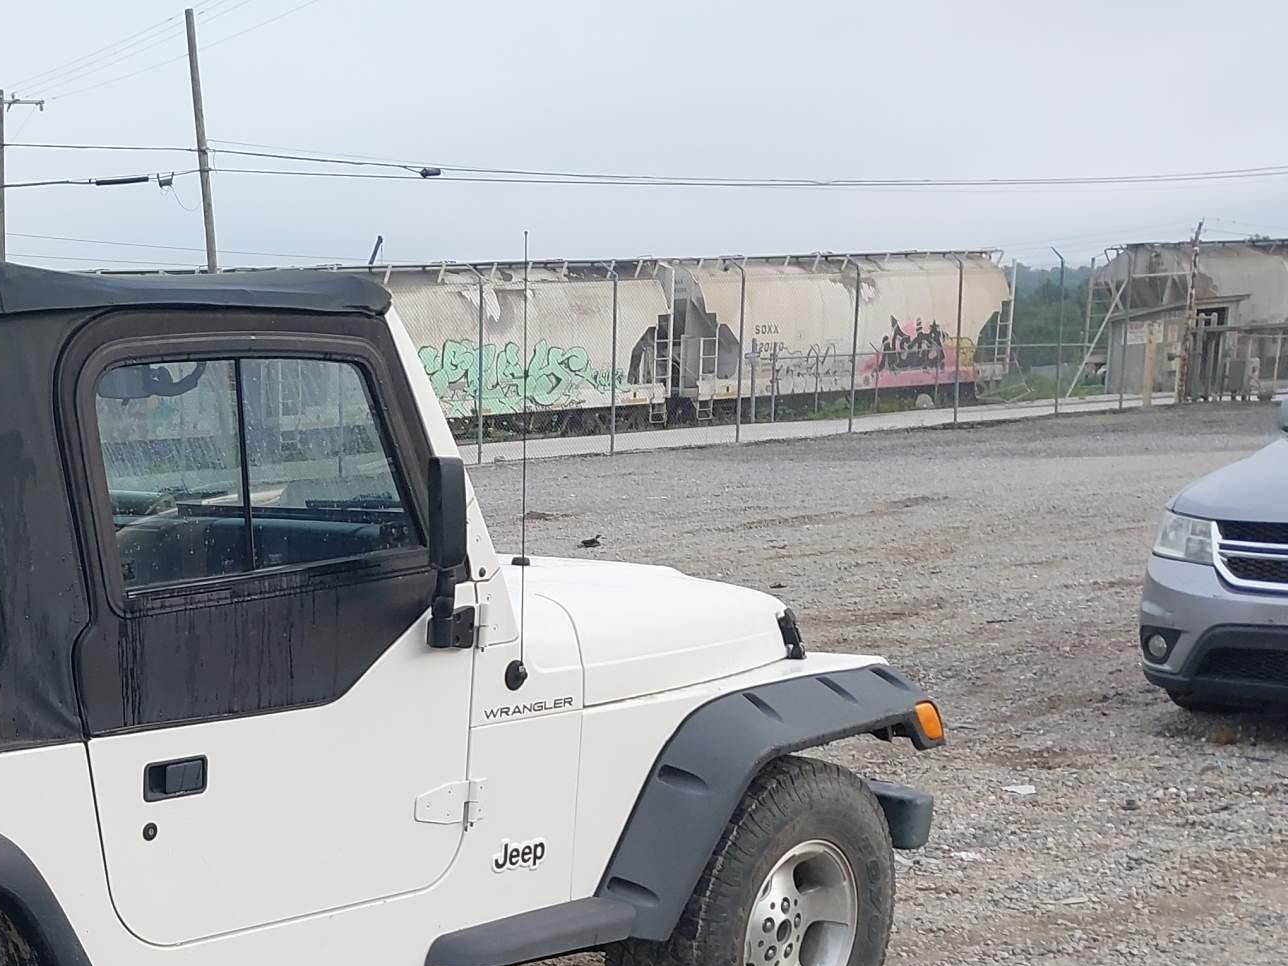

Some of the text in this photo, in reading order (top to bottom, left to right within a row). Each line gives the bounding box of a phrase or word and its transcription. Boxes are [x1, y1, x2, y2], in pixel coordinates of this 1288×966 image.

[754, 324, 779, 335] SOXX
[484, 696, 574, 720] WRANGLER
[493, 840, 546, 869] Jeep
